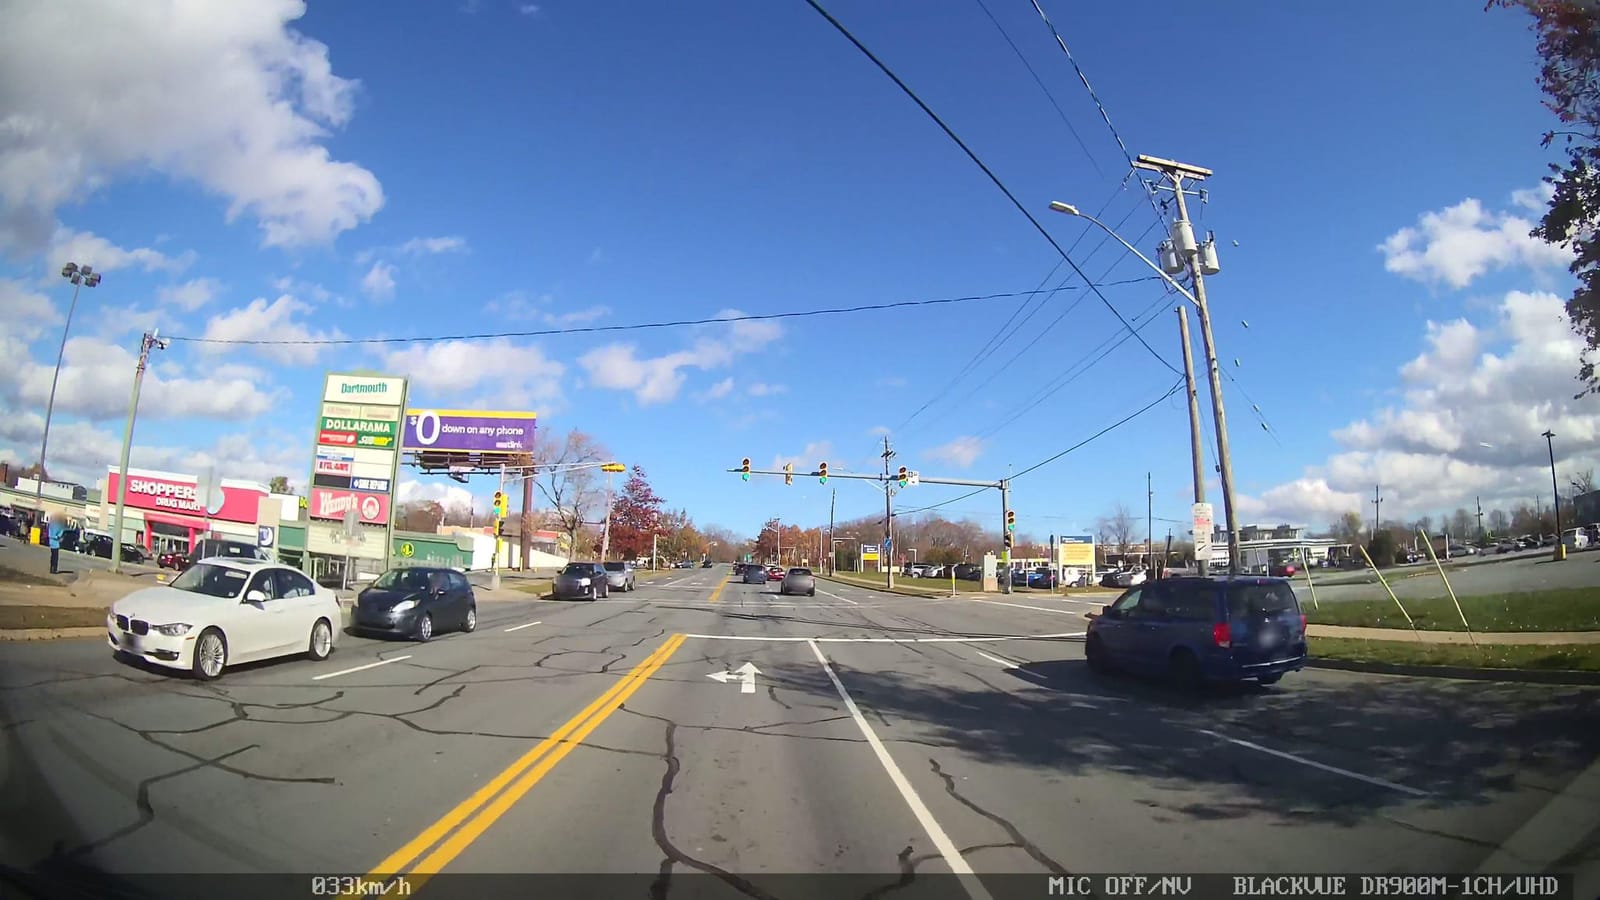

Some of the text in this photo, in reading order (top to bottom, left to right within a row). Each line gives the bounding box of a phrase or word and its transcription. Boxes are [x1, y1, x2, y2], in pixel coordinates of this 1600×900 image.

[341, 382, 388, 394] Dartmouth
[325, 419, 391, 433] DOLLARAMA
[441, 424, 466, 434] down
[466, 426, 478, 435] on
[478, 427, 496, 437] any
[496, 426, 524, 437] phone
[155, 497, 178, 509] DRUG
